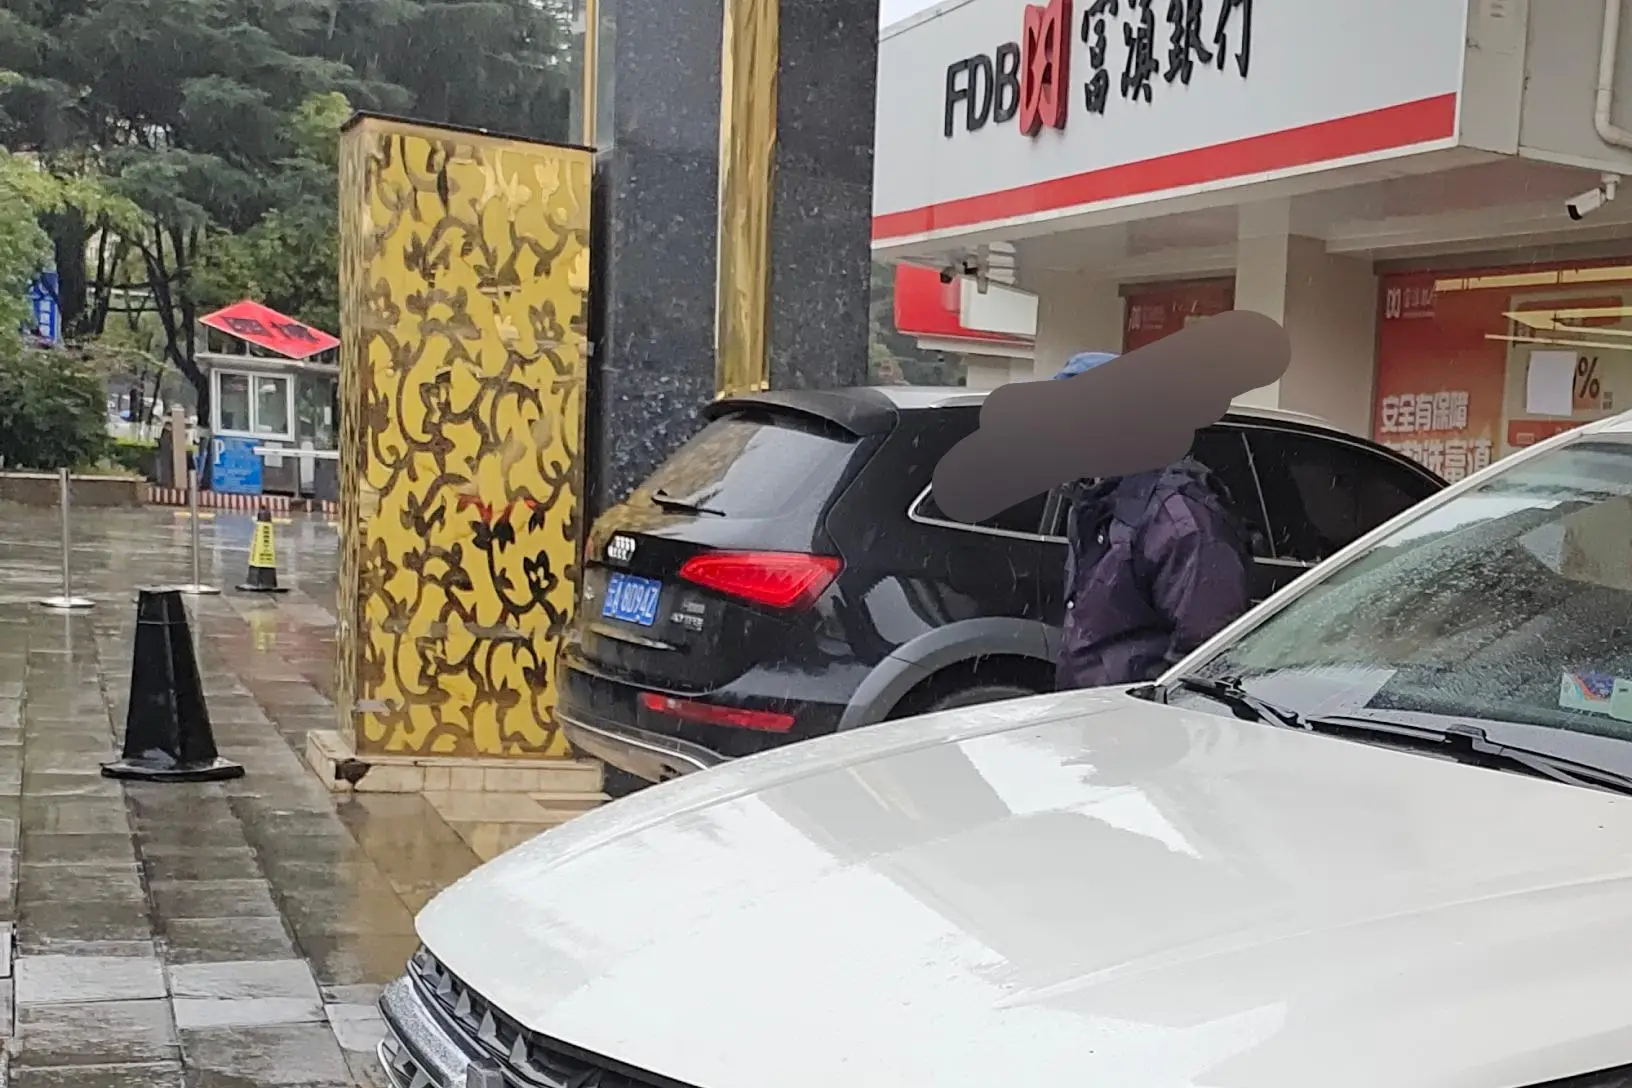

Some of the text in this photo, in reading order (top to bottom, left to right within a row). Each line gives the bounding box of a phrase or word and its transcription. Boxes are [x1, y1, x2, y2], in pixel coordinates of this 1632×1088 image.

[944, 41, 1022, 138] FDB
[1380, 391, 1468, 433] 安全有保障
